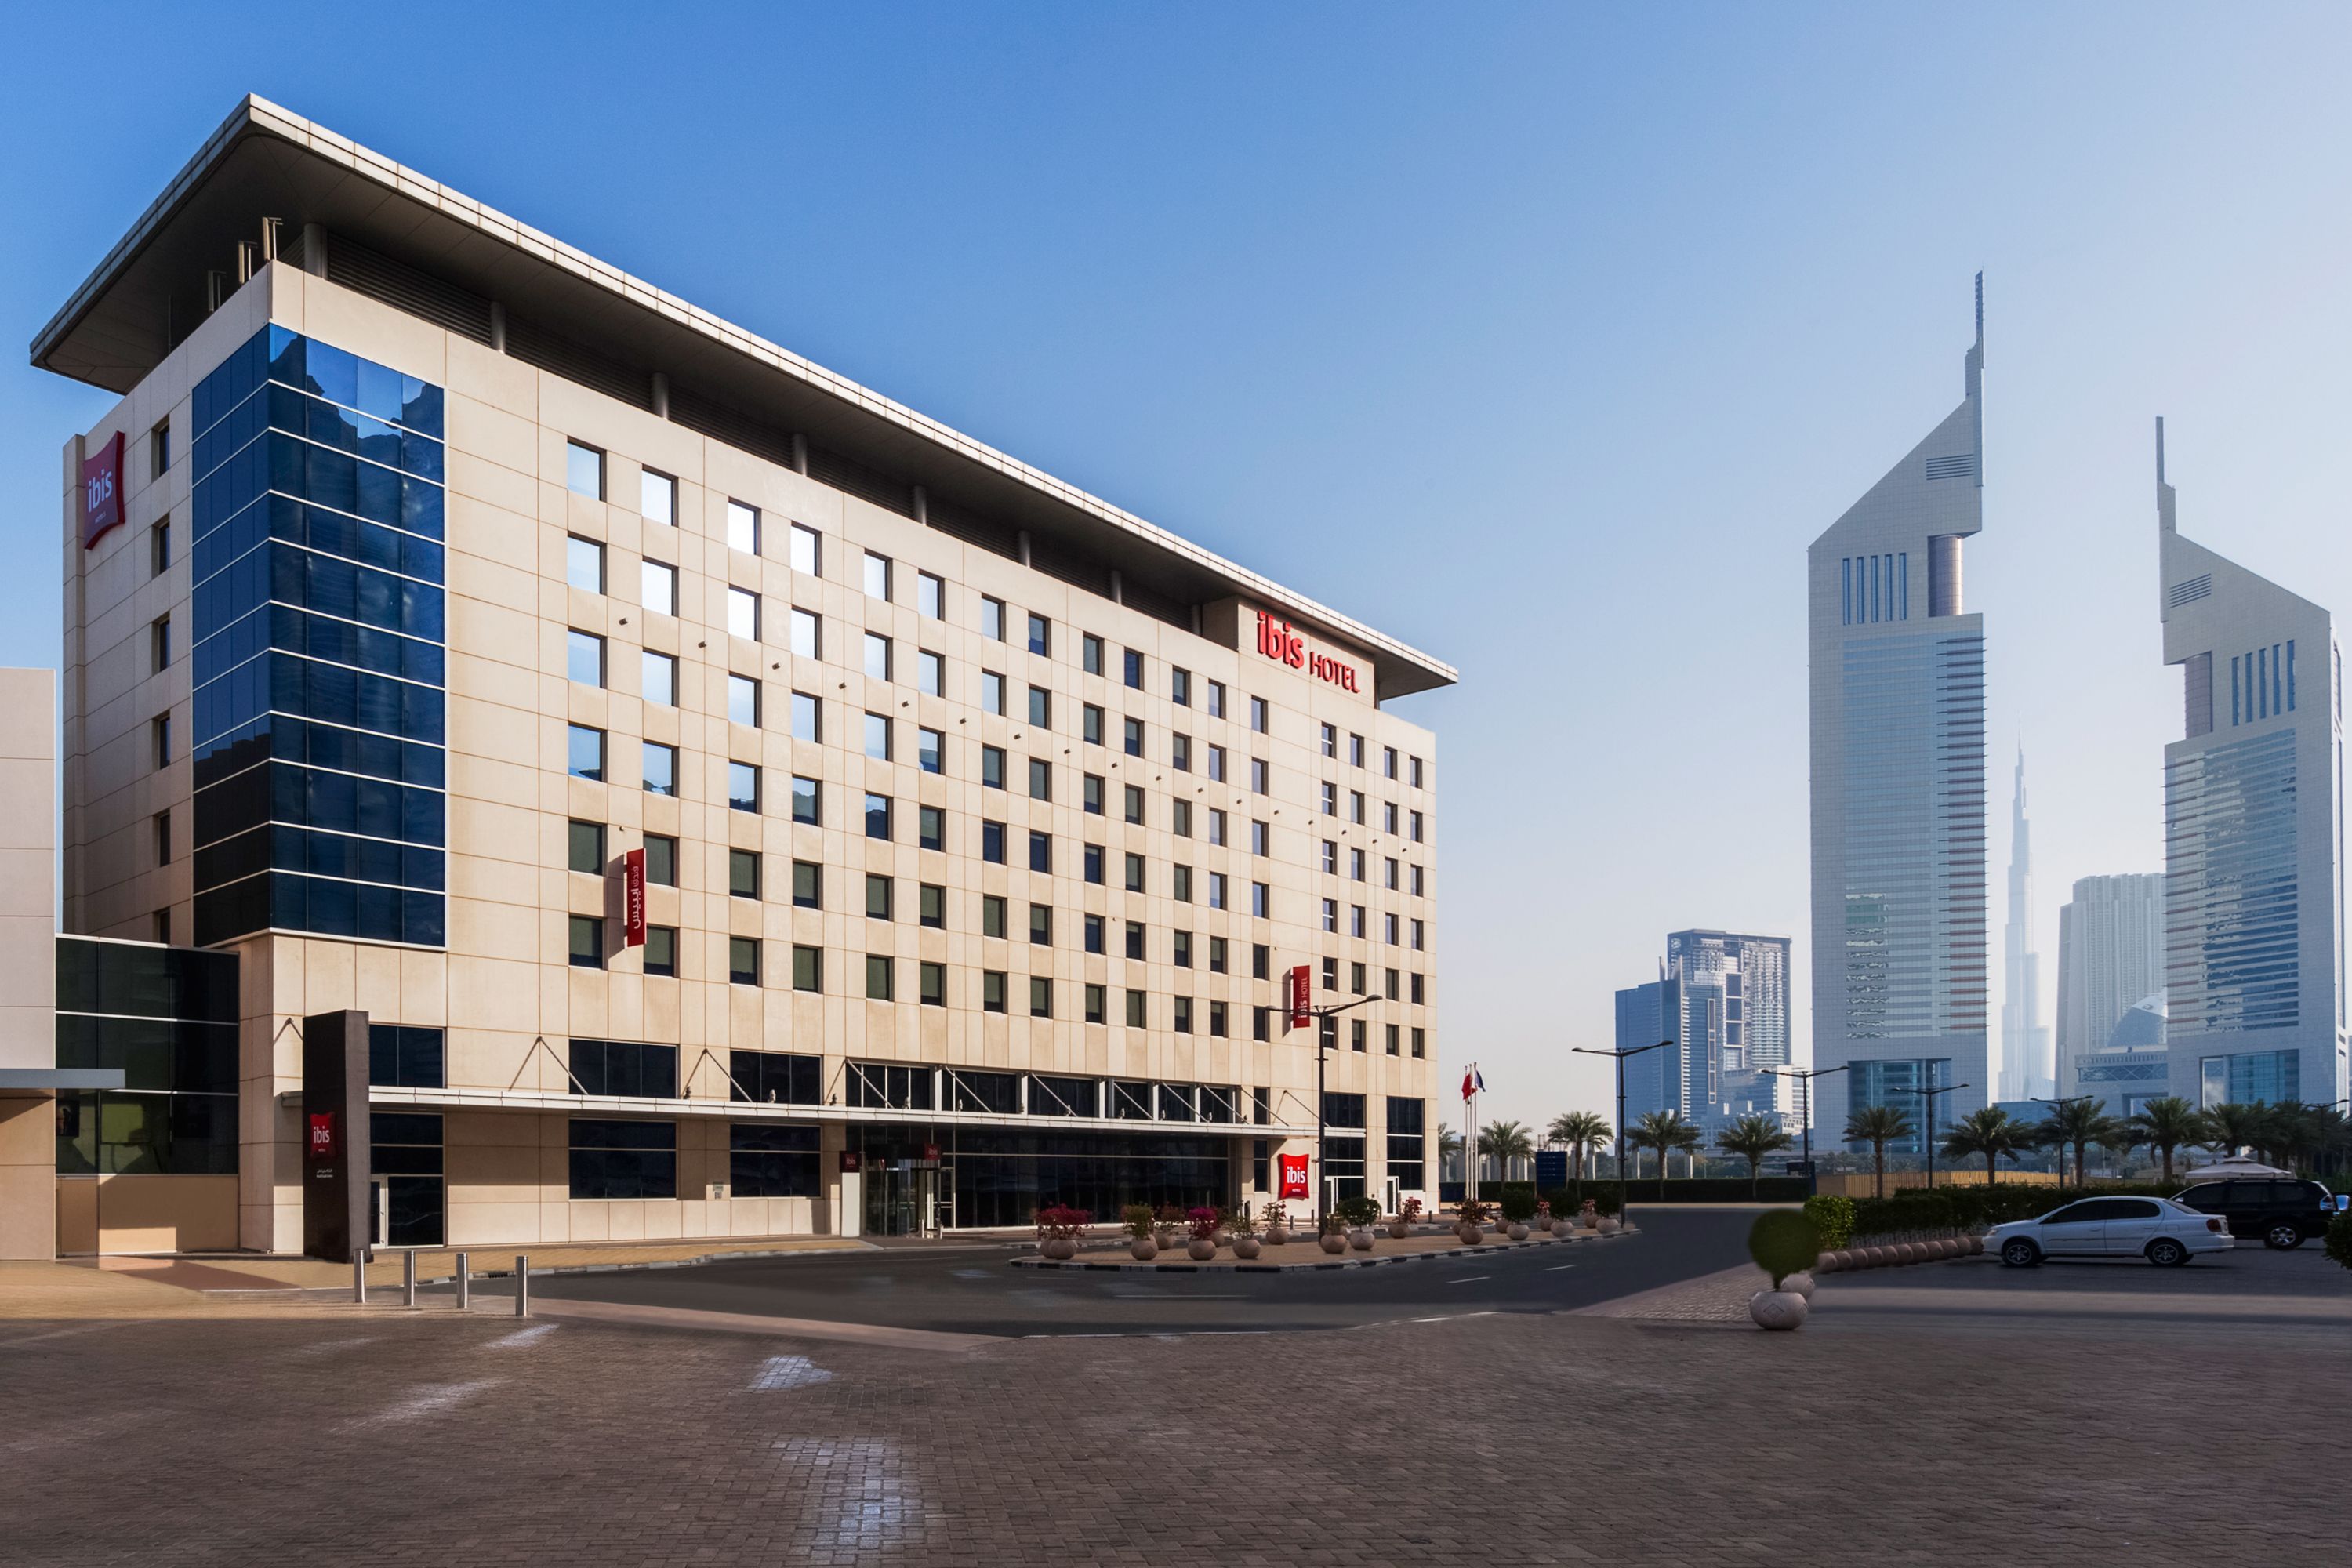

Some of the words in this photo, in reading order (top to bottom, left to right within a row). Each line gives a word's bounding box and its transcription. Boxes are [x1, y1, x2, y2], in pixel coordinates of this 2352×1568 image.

[88, 468, 112, 513] ibis
[1257, 611, 1305, 669] ibis
[1309, 652, 1360, 694] HOTEL
[314, 1126, 330, 1143] ibis
[928, 1147, 938, 1156] ibis
[846, 1156, 856, 1165] ibis
[1287, 1166, 1305, 1184] ibis
